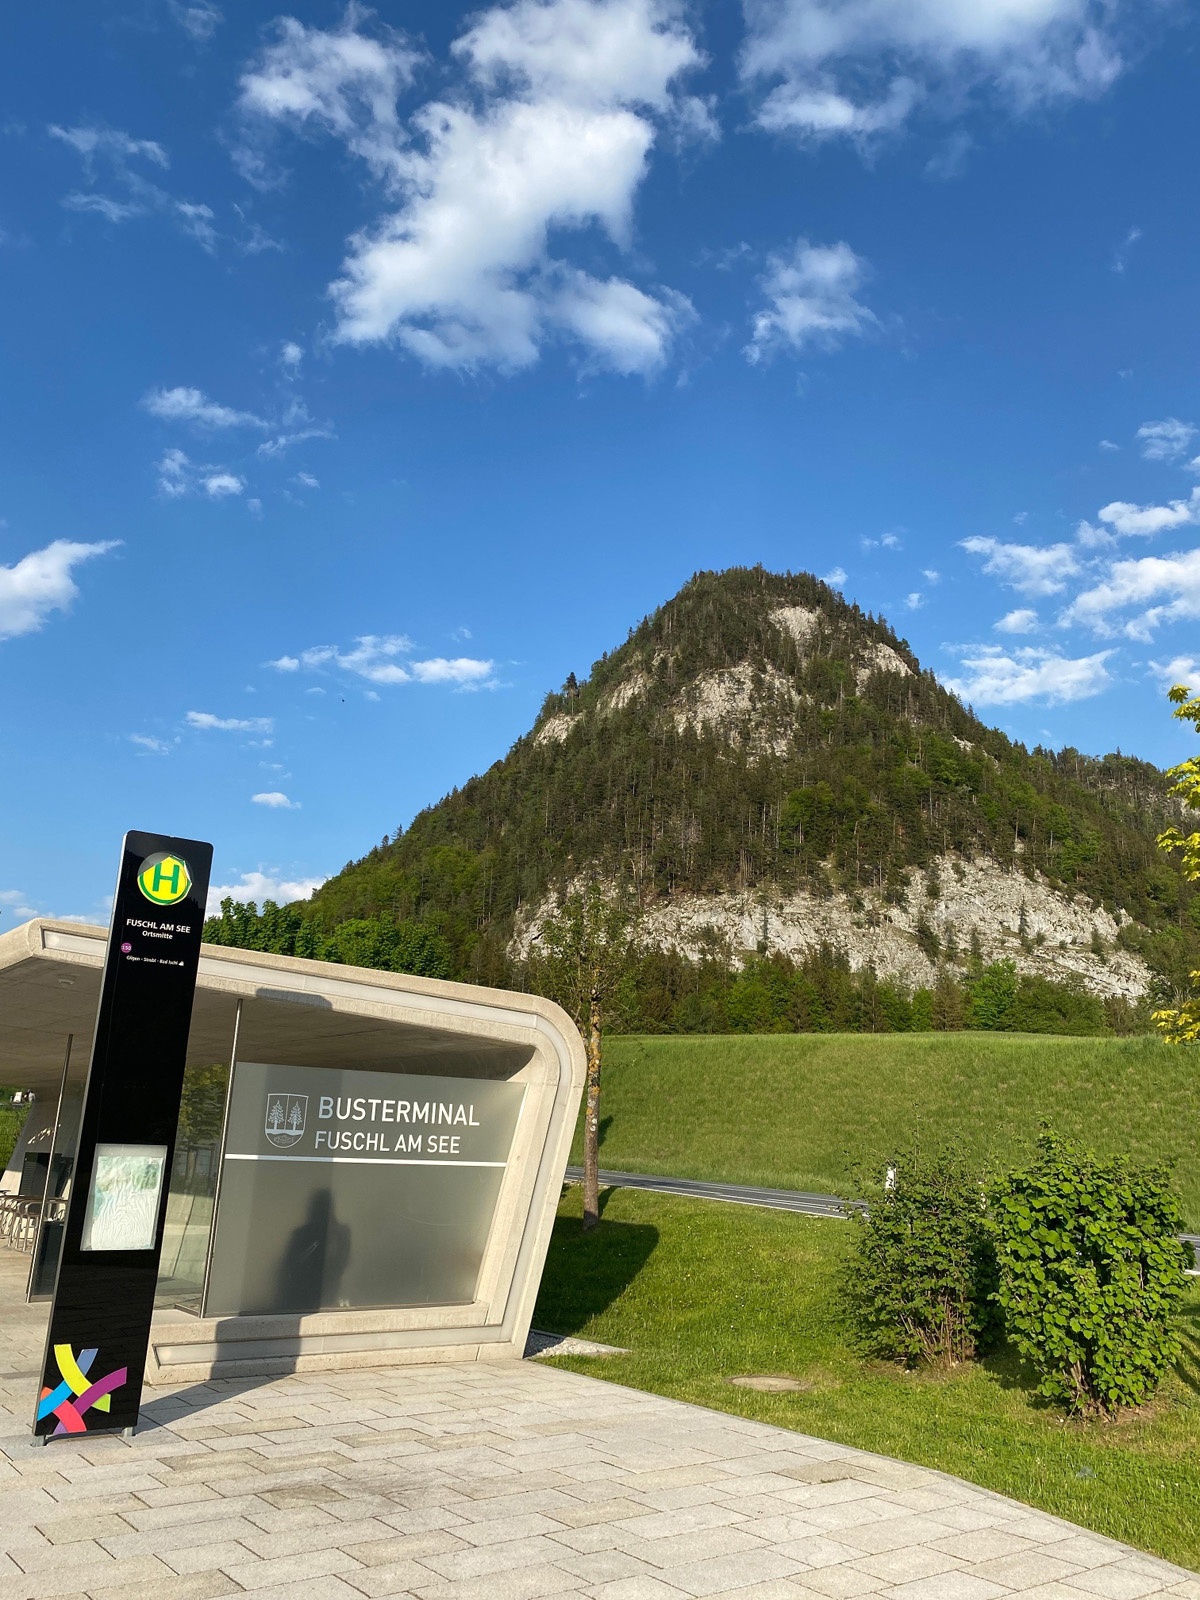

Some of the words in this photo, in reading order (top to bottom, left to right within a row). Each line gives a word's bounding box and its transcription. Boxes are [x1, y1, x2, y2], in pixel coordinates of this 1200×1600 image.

[152, 863, 180, 894] H
[126, 918, 158, 929] FUSCHL
[159, 923, 175, 931] AM
[176, 924, 191, 934] SEE
[142, 930, 173, 940] Ortsmitte
[318, 1096, 480, 1126] BUSTERMINAL
[314, 1130, 390, 1152] FUSCHL
[394, 1134, 422, 1153] AM
[426, 1135, 461, 1154] SEE
